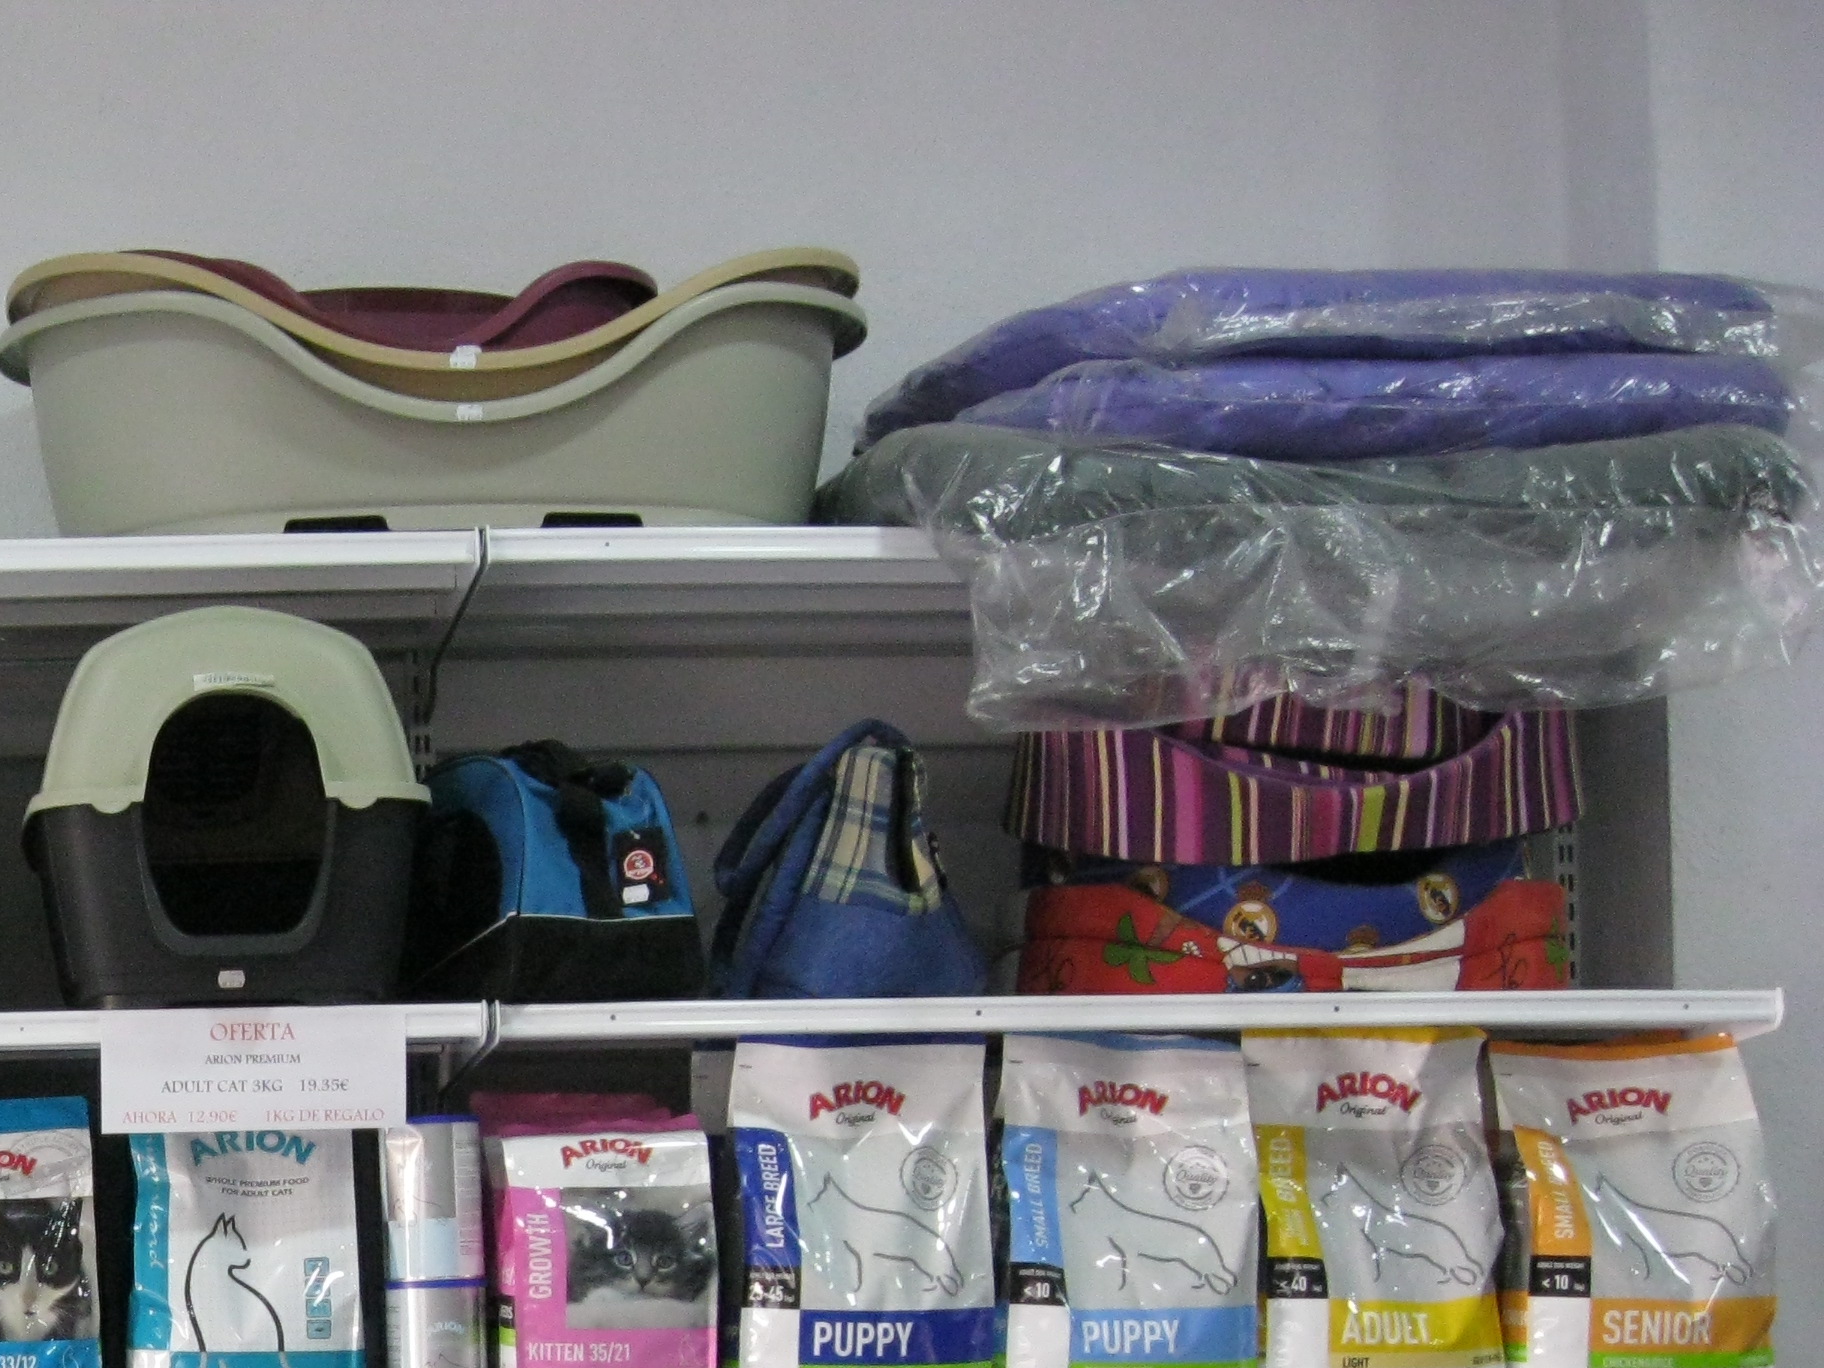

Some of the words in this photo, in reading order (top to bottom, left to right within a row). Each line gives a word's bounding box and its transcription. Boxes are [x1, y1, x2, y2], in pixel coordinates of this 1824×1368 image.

[210, 1023, 295, 1041] OFERTA
[205, 1055, 242, 1065] ARION
[245, 1054, 301, 1064] PREMIUM
[161, 1080, 213, 1093] ADULT
[217, 1080, 248, 1092] CAT
[252, 1079, 283, 1092] 3KG
[300, 1079, 350, 1091] 19.35€
[808, 1080, 907, 1120] ARION
[1078, 1080, 1169, 1116] ARION
[1315, 1072, 1421, 1113] ARION
[122, 1111, 177, 1124] AHORA
[188, 1110, 237, 1123] 12.90€
[266, 1110, 295, 1122] 1KG
[299, 1110, 320, 1121] DE
[323, 1108, 385, 1121] REGALO
[1567, 1086, 1672, 1123] ARION
[1595, 1109, 1644, 1125] Original
[190, 1130, 316, 1166] ARION
[561, 1138, 653, 1168] ARION
[1026, 1143, 1045, 1189] BREED
[239, 1177, 281, 1188] PREMIUM
[283, 1175, 310, 1186] FOOD
[764, 1143, 780, 1190] BREED
[241, 1187, 269, 1197] ADULT
[271, 1186, 294, 1196] CATS
[766, 1194, 785, 1249] LARGE
[1033, 1194, 1049, 1249] SMALL
[1550, 1188, 1577, 1241] SMALL
[529, 1213, 553, 1300] GROWTH
[813, 1321, 914, 1357] PUPPY
[1082, 1318, 1180, 1354] PUPPY
[1343, 1310, 1431, 1345] ADULT
[1602, 1309, 1712, 1345] SENIOR
[528, 1343, 584, 1361] KITTEN
[589, 1342, 631, 1361] 35/21
[1342, 1356, 1371, 1368] LIGHT
